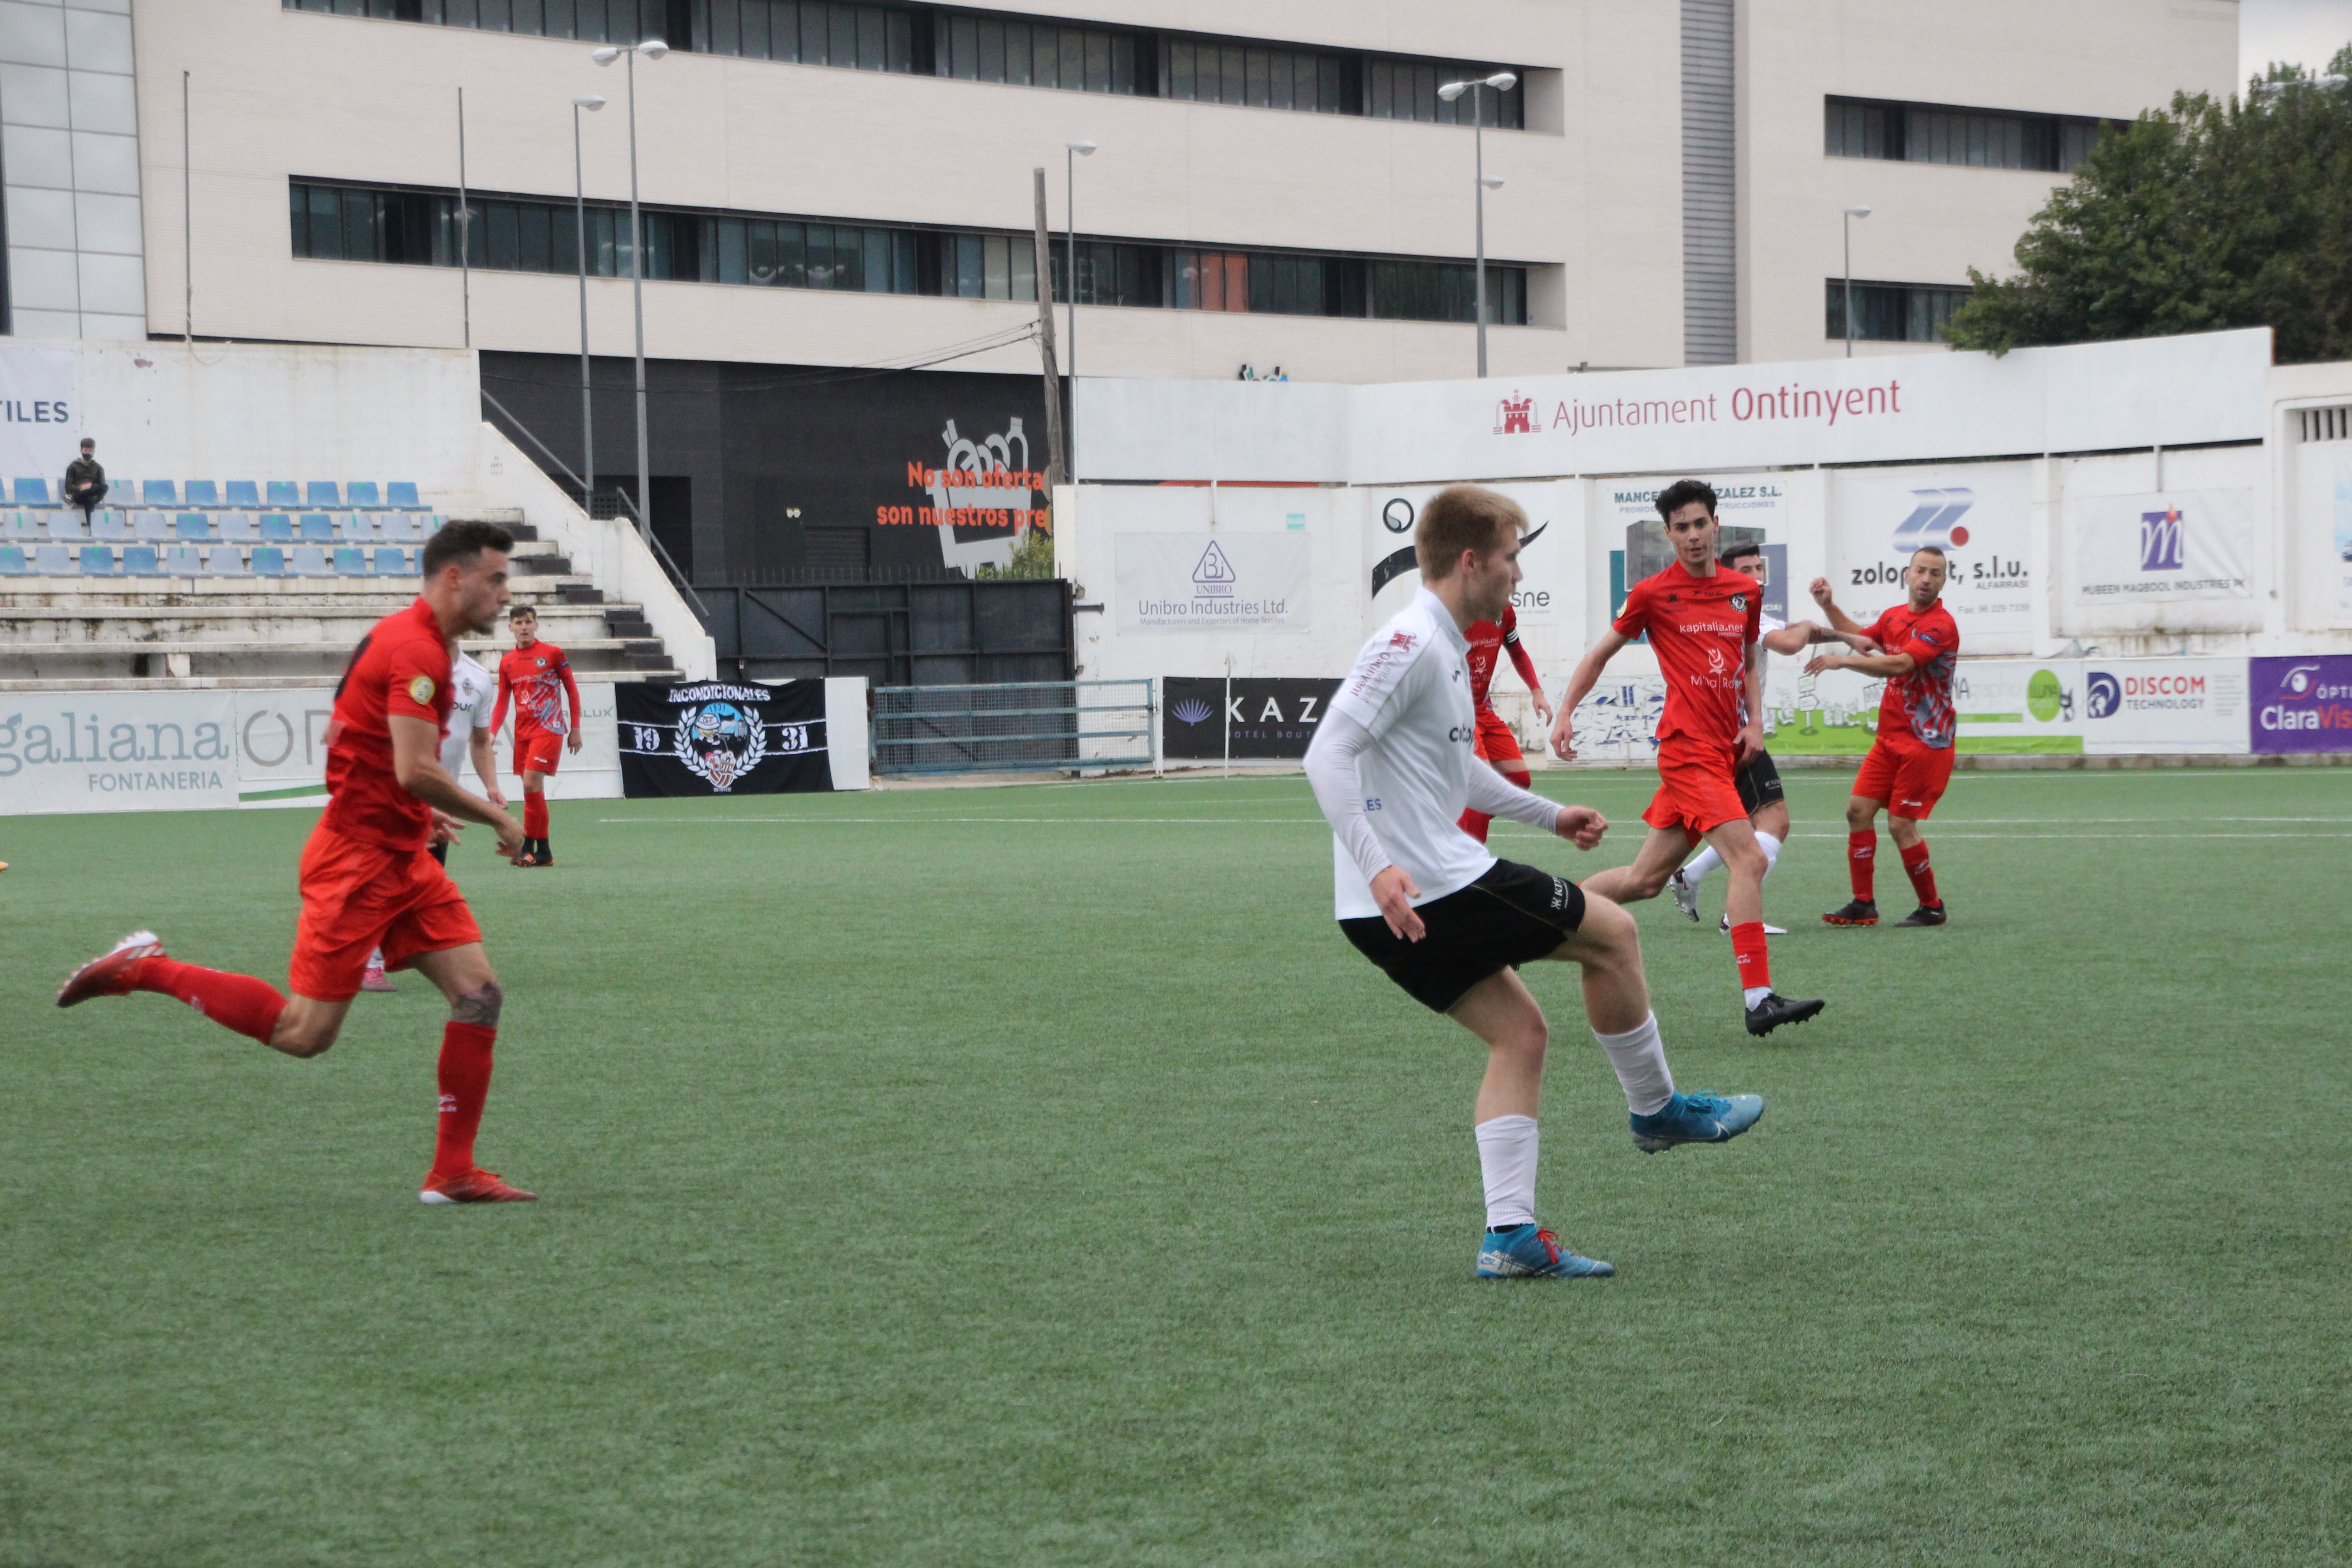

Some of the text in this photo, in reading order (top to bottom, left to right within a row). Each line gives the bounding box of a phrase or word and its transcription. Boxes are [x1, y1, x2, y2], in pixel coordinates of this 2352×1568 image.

[0, 401, 69, 423] ILES
[1553, 380, 1901, 436] Ajuntament Ontinyent
[908, 461, 1043, 490] No son oferta
[1614, 485, 1782, 503] MANCE ZALEZ S.L.
[1716, 501, 1775, 510] TRUCCIONES
[877, 504, 1045, 536] son nuestros pre
[1851, 555, 2028, 590] zolopt, s.l.u.
[1196, 585, 1232, 595] UNIBRO
[1512, 591, 1550, 607] sne
[1138, 598, 1289, 615] Unibro Industries Ltd.
[1202, 617, 1231, 626] Exporters
[666, 684, 771, 703] INCONDICIONALES
[2125, 676, 2206, 696] DISCOM
[709, 704, 727, 713] 1931
[1225, 697, 1318, 723] KAZ
[2126, 699, 2205, 710] TECHNOLOGY
[2260, 703, 2352, 731] ClaraVis
[0, 712, 230, 777] galiana
[634, 725, 809, 751] 19 31
[1229, 730, 1312, 739] OTEL BOUT
[89, 770, 224, 792] FONTANERIA
